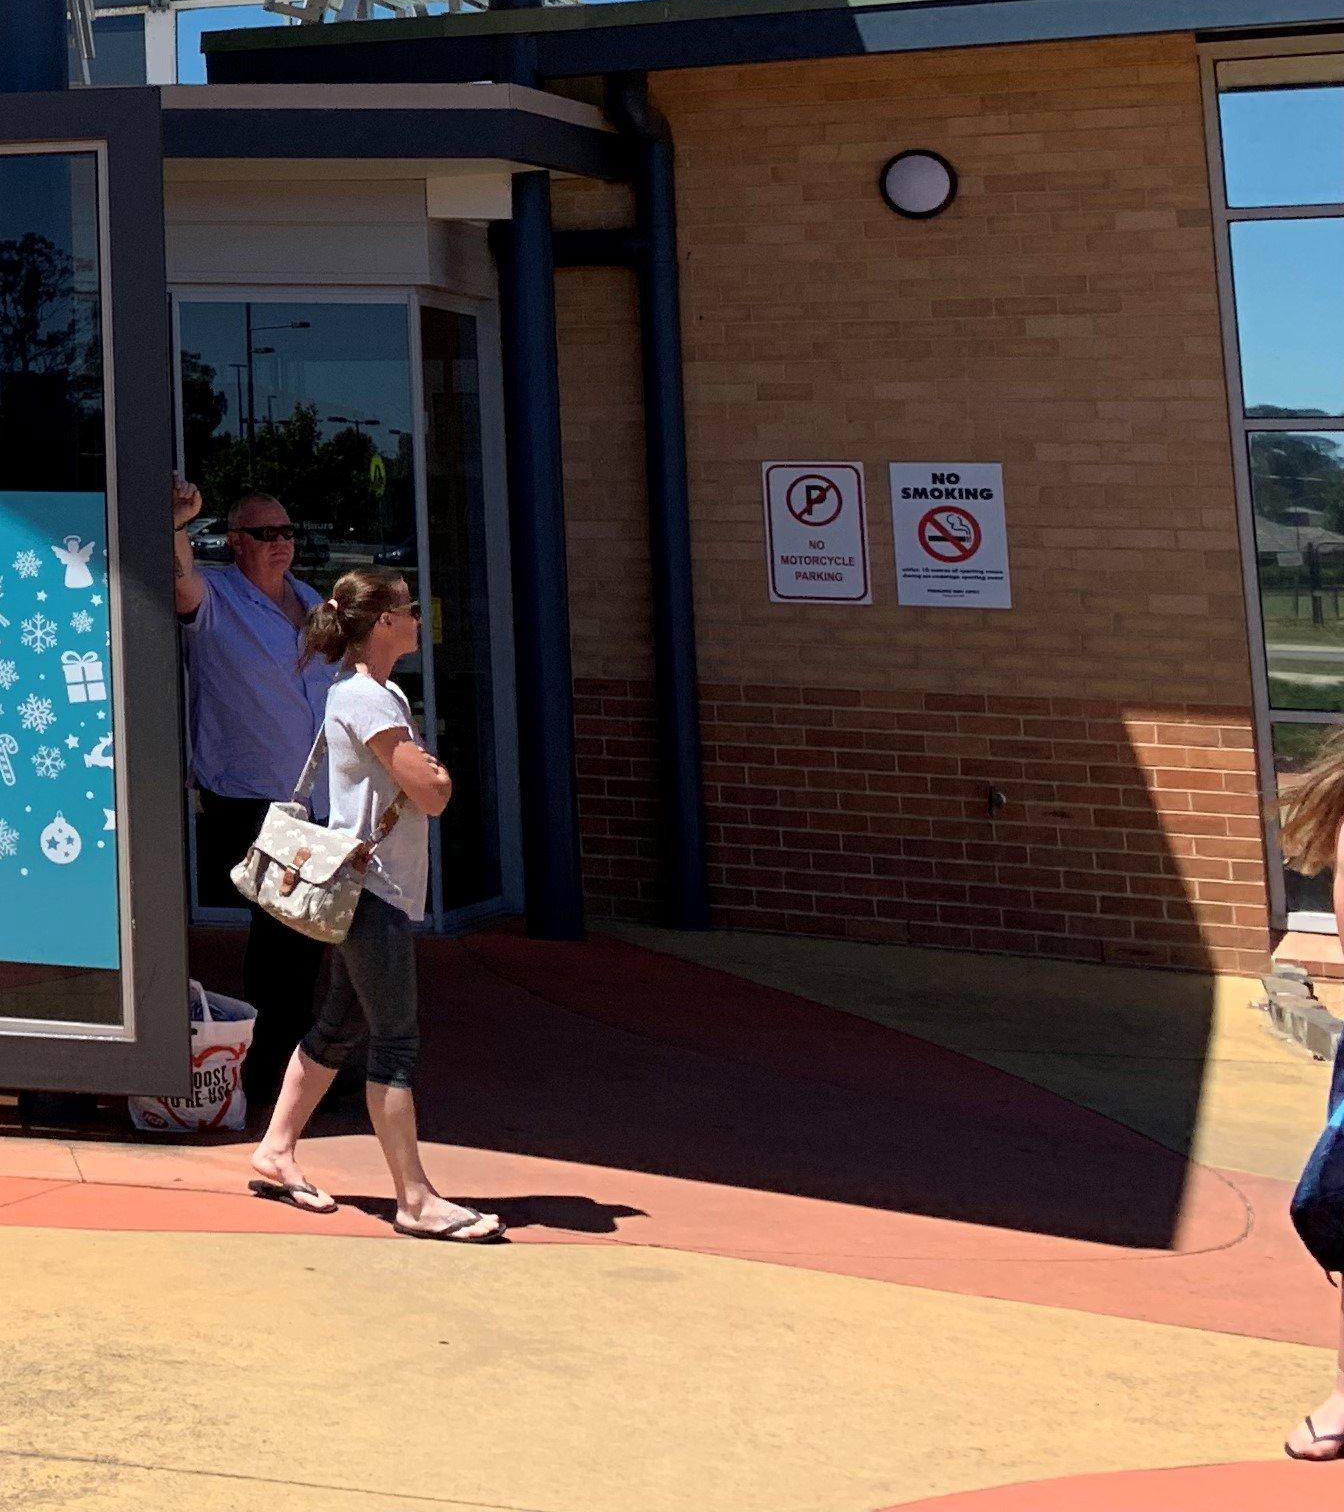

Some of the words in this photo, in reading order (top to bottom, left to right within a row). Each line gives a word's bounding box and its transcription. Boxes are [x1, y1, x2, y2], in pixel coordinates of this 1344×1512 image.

[931, 472, 960, 485] NO
[901, 487, 994, 501] SMOKING
[809, 540, 825, 550] NO
[780, 555, 855, 567] MOTORCYCLE
[795, 571, 843, 582] PARKING
